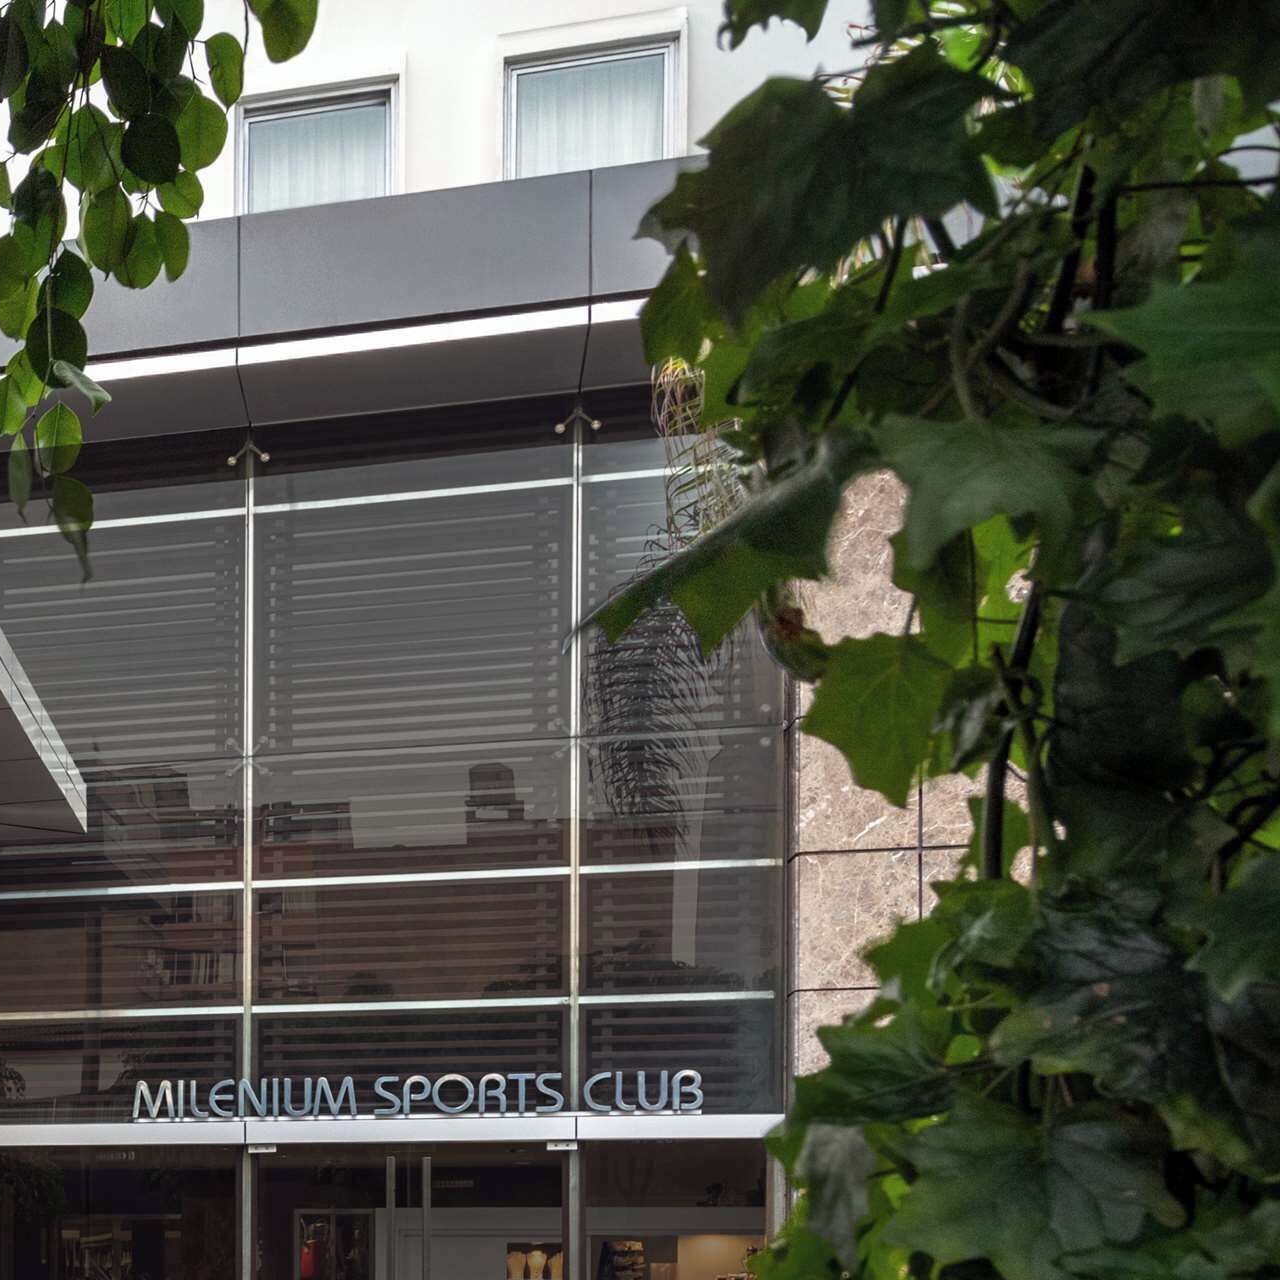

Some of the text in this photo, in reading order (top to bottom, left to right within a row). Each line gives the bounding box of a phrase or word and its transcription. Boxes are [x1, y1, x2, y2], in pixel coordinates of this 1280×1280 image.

[131, 1069, 704, 1118] MILENIUM SPORTS CLUB
